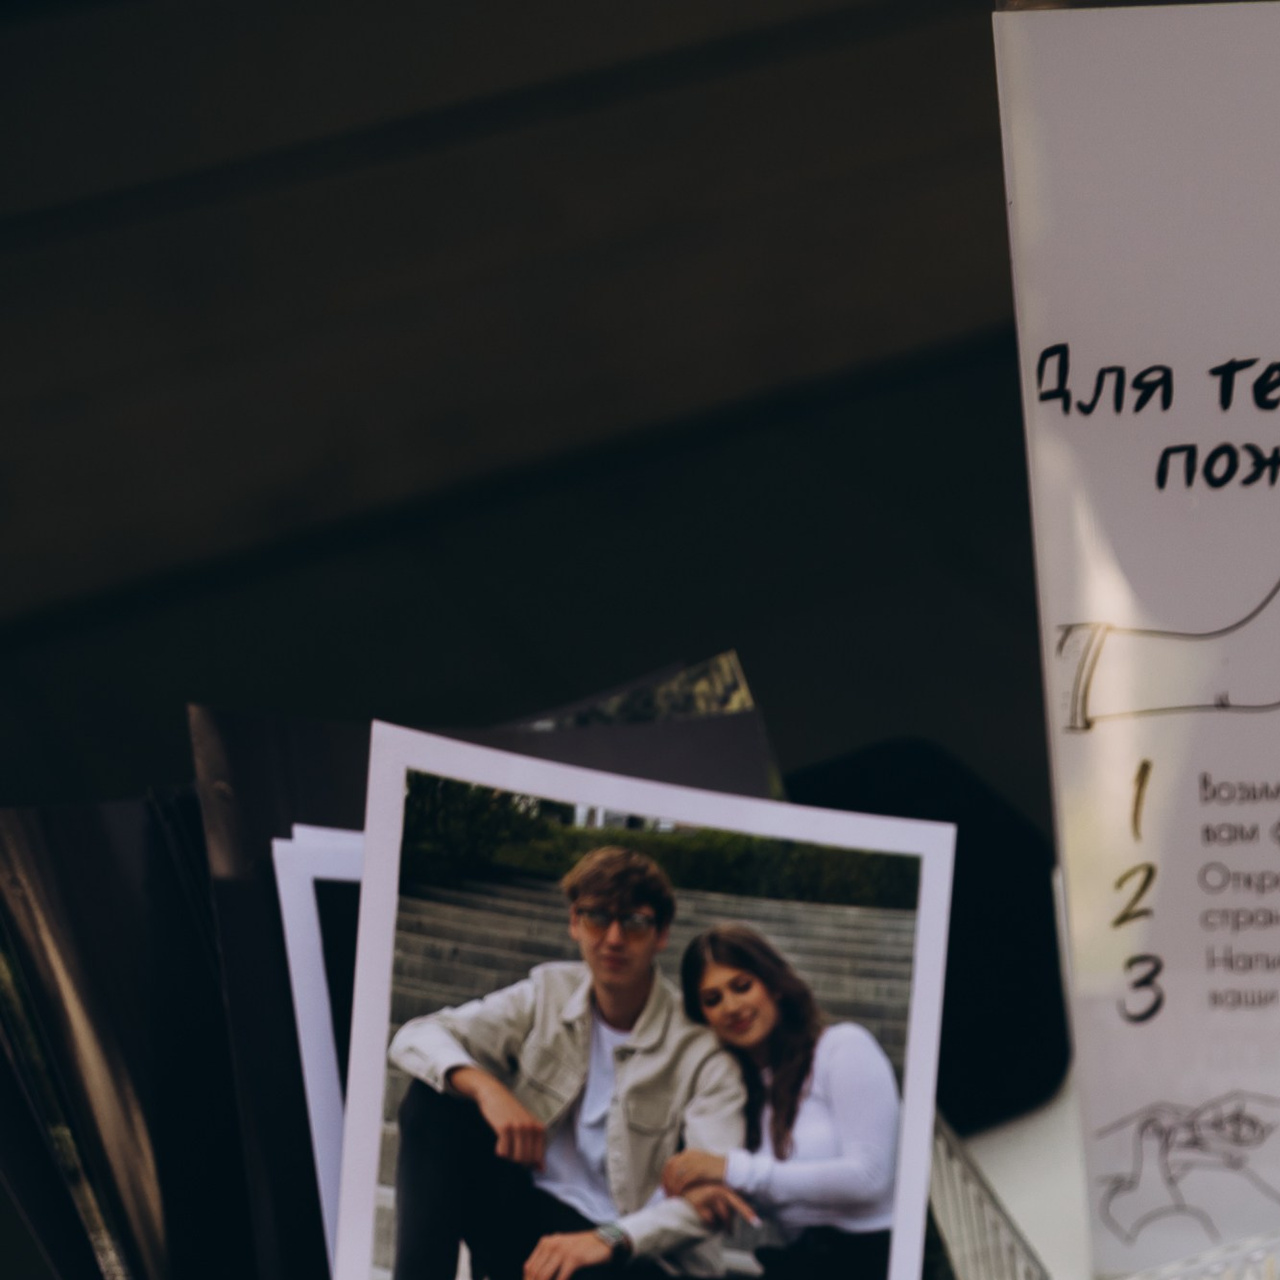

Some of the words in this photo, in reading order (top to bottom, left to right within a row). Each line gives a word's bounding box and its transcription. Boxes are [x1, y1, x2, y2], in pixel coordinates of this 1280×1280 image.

[1037, 342, 1174, 416] Для
[1131, 758, 1153, 843] 1
[1202, 821, 1260, 847] вам
[1111, 863, 1159, 928] 2
[1115, 953, 1165, 1024] 3
[1208, 986, 1278, 1012] ваши
